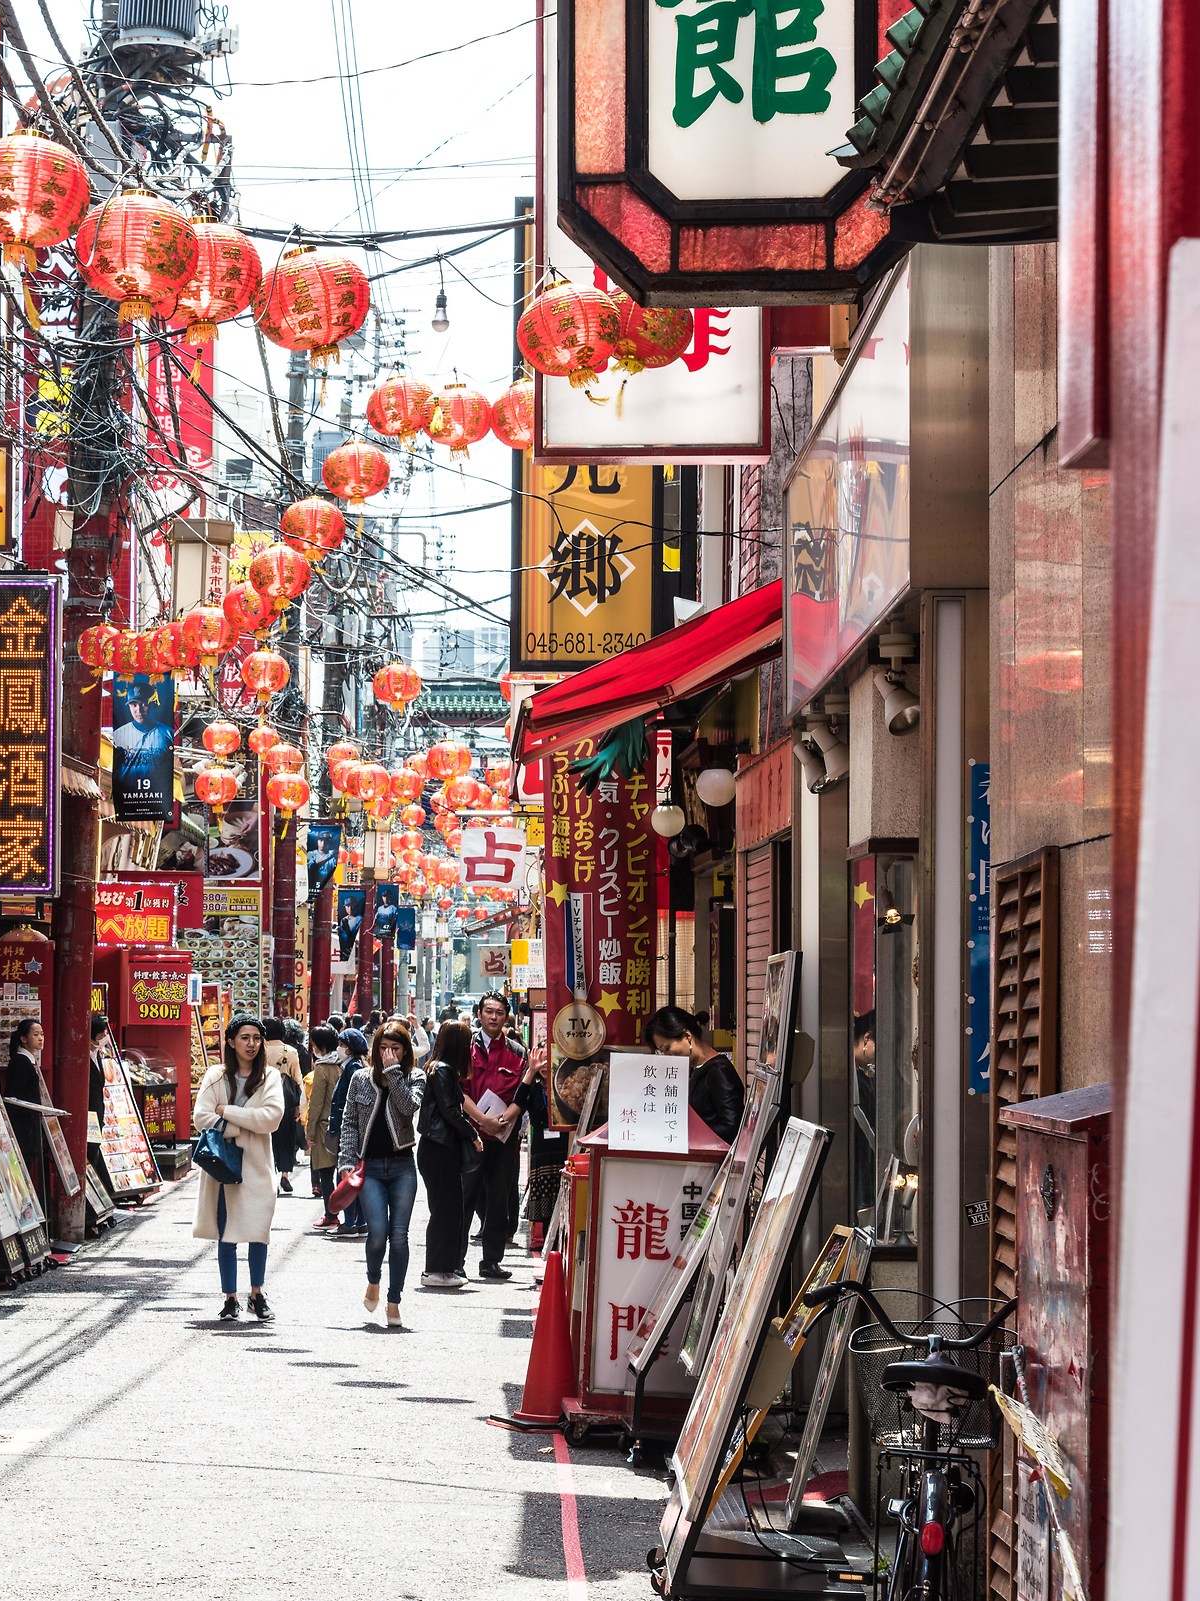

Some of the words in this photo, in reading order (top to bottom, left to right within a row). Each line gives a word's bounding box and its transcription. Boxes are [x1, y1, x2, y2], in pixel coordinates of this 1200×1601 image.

[136, 779, 151, 790] 19
[463, 832, 523, 883] 占
[484, 951, 506, 974] 占
[132, 981, 187, 1002] 食べ放題
[139, 1003, 181, 1020] 980円
[568, 1018, 592, 1030] TV
[642, 1064, 658, 1114] 飲食は
[663, 1065, 679, 1144] 店舗前です
[619, 1107, 638, 1142] 禁止
